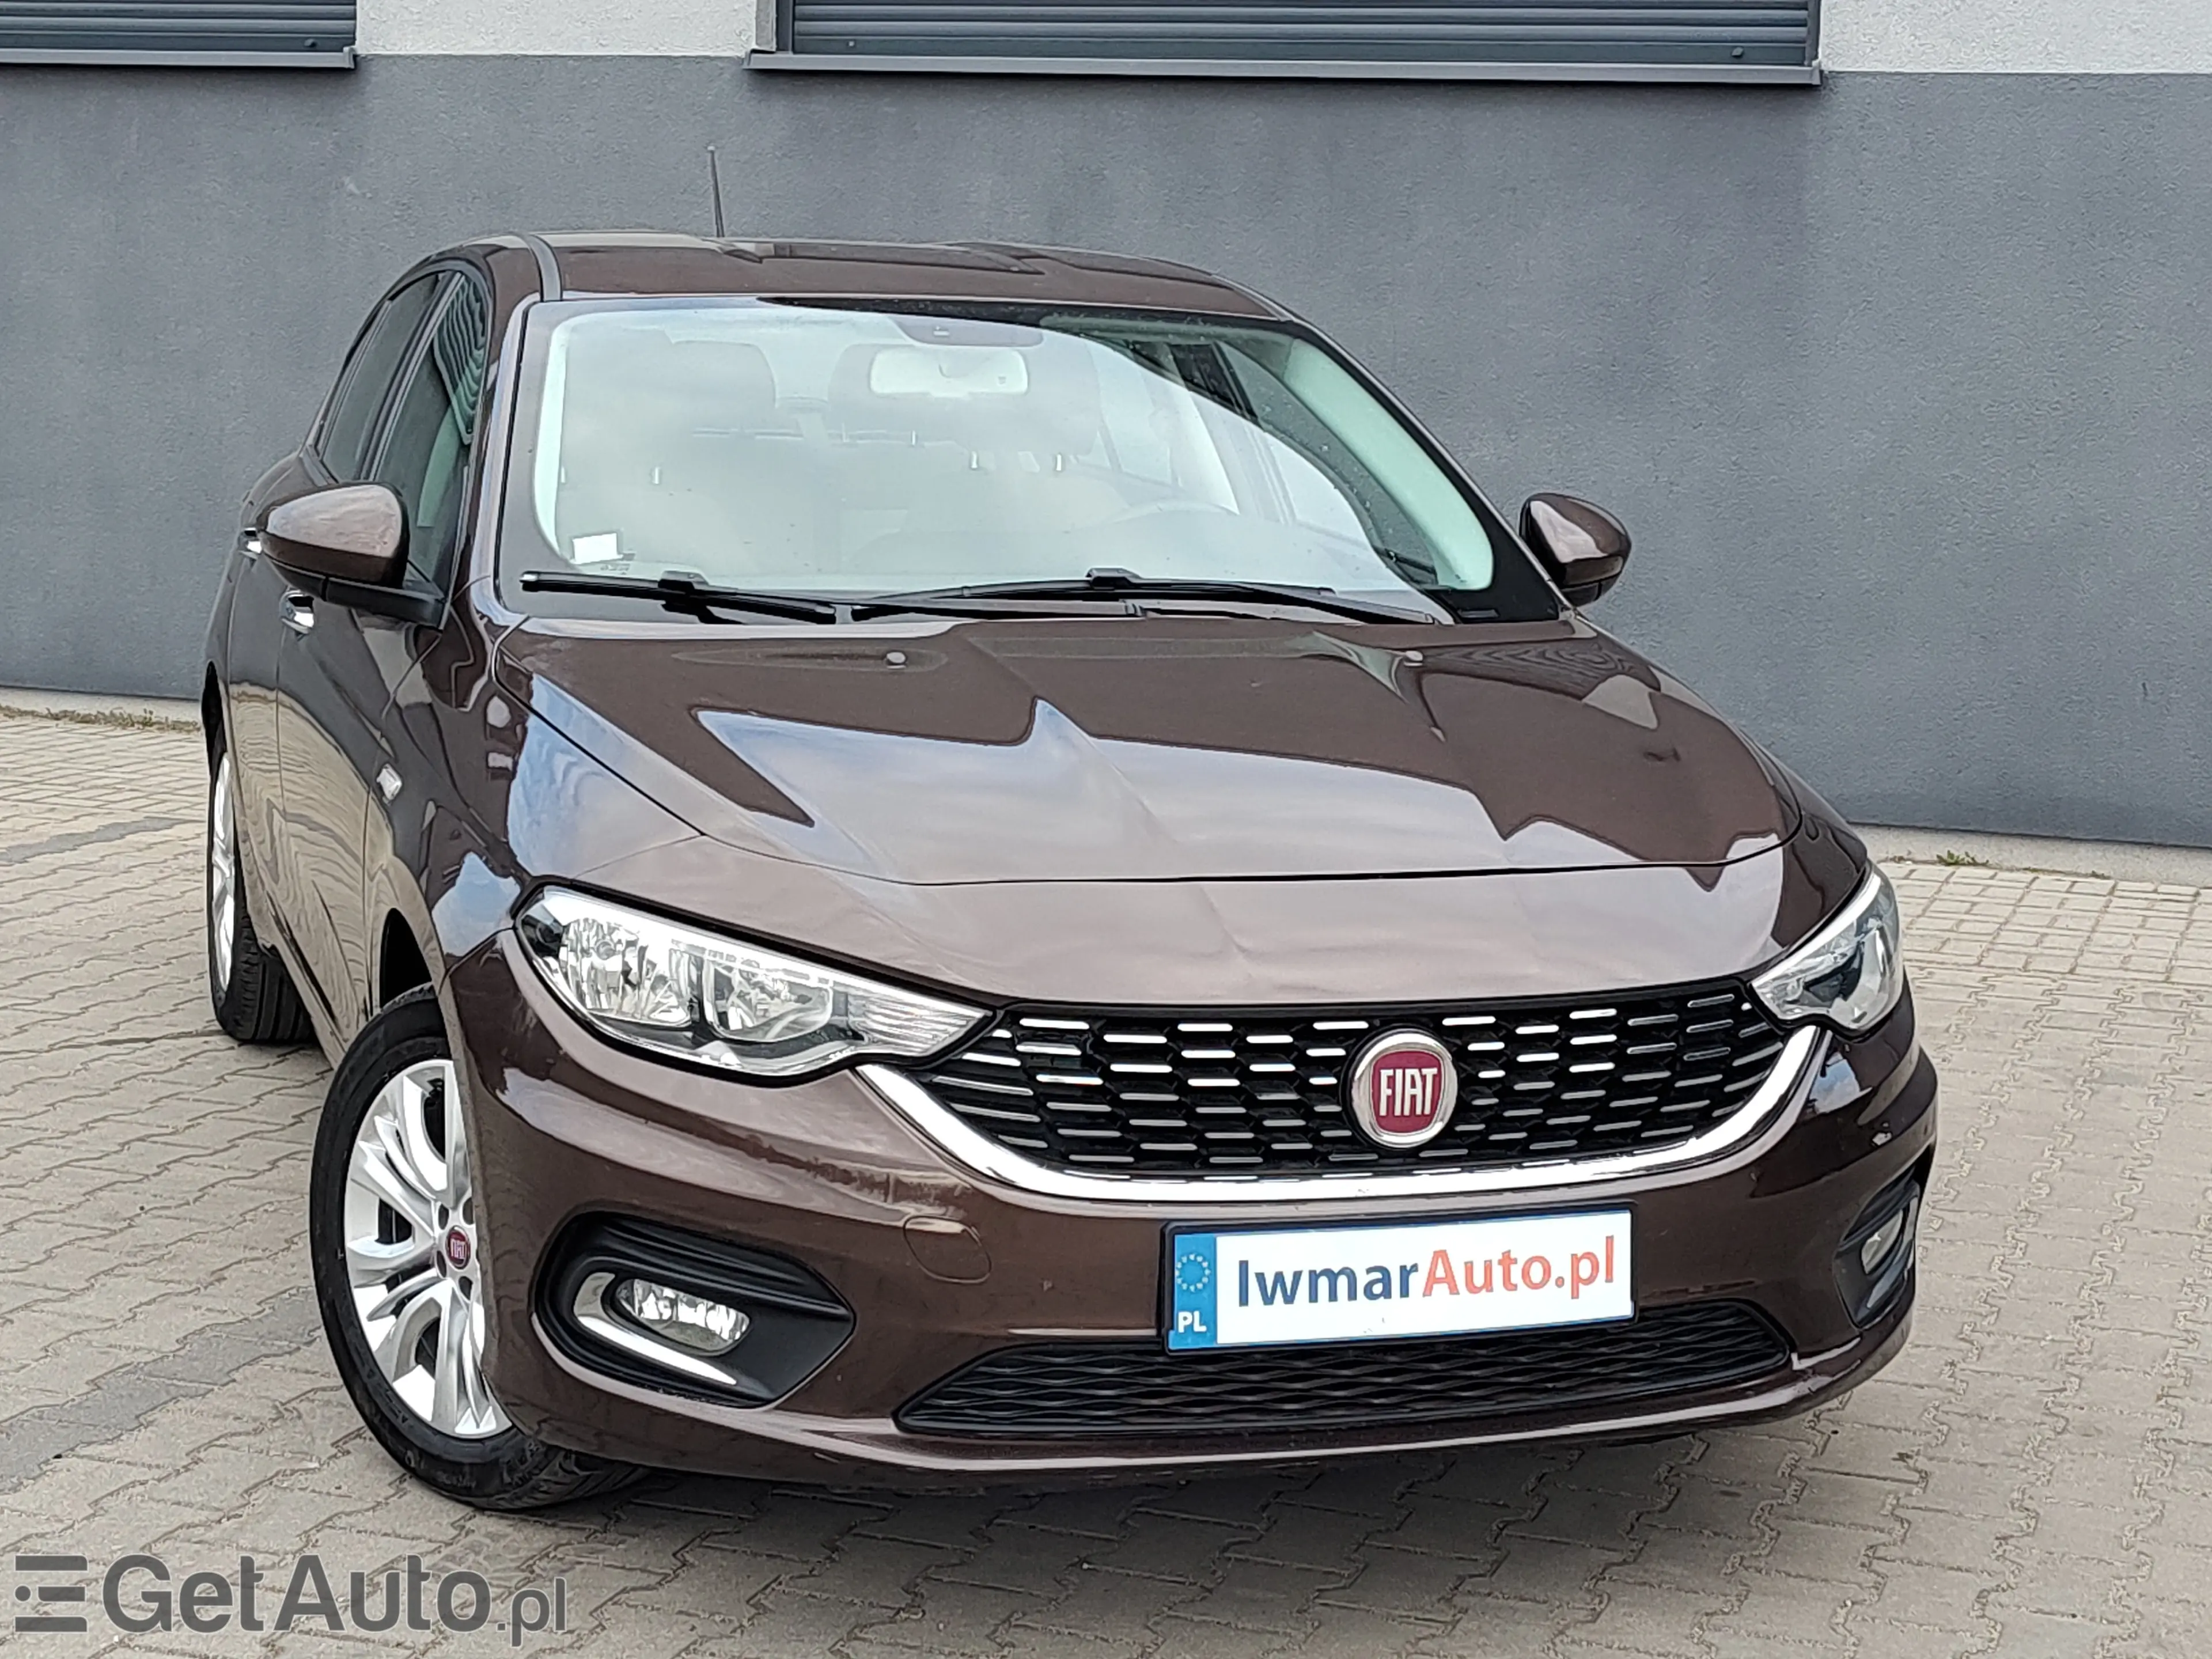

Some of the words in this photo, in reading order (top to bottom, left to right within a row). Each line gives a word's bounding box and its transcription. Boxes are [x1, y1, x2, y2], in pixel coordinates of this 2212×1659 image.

[1379, 1067, 1438, 1116] FIAT
[1237, 1236, 1615, 1308] IwmarAuto.pl
[1177, 1310, 1207, 1334] PL
